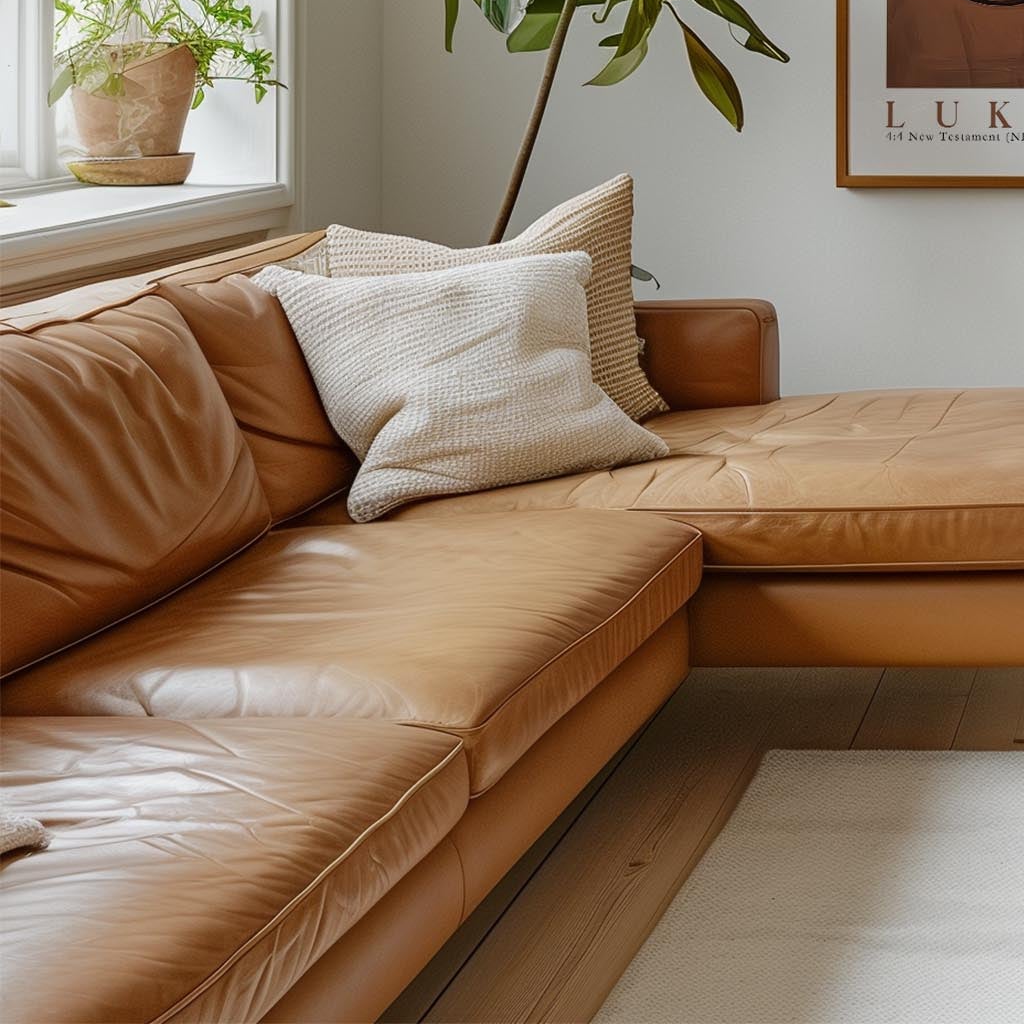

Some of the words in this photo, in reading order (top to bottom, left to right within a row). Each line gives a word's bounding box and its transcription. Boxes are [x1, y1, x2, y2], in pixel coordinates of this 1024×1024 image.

[885, 132, 903, 142] 4:4
[907, 132, 934, 142] New
[939, 131, 1000, 142] Testament
